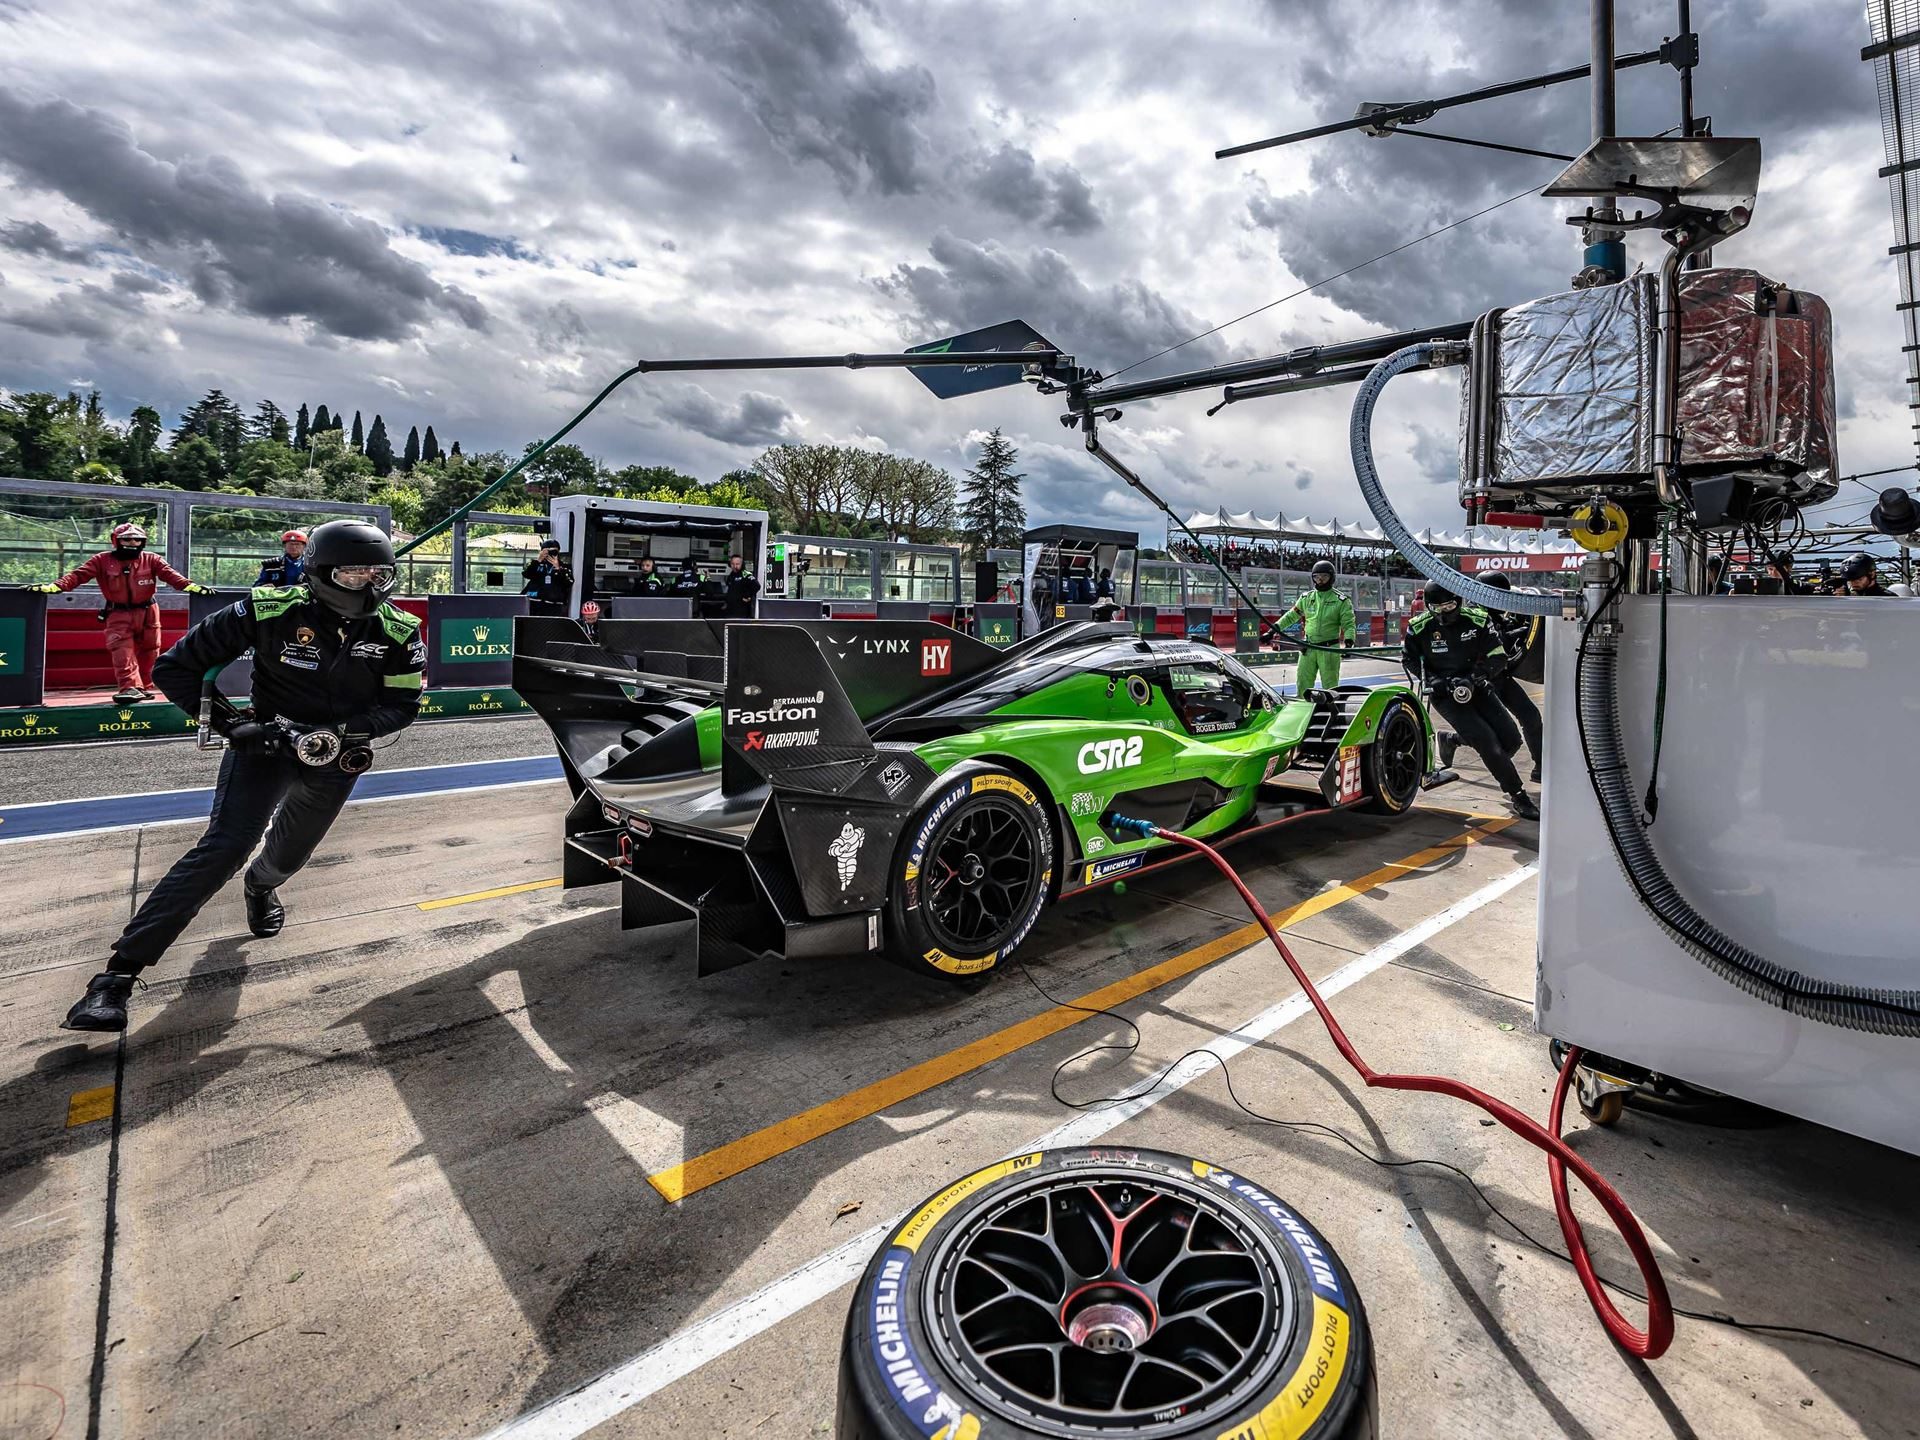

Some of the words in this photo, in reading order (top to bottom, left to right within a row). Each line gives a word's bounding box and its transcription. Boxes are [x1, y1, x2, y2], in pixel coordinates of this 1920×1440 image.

[1476, 556, 1529, 569] MOTUL
[258, 604, 279, 612] OMP
[1056, 607, 1064, 616] 83
[390, 624, 408, 635] OMP
[1188, 624, 1210, 634] WEC
[984, 635, 1011, 643] ROLEX
[352, 641, 389, 654] WEC
[450, 644, 511, 656] ROLEX
[864, 640, 910, 653] LYNX
[923, 645, 949, 670] HY
[469, 702, 503, 711] ROLEX
[773, 696, 816, 705] PERTAMINA
[727, 706, 816, 726] Fastron
[1, 726, 59, 738] ROLEX
[98, 721, 151, 732] ROLEX
[1196, 724, 1216, 733] ROGER
[1217, 721, 1237, 731] DUBUIS
[1077, 735, 1144, 774] CSR2
[976, 779, 994, 787] PILOT
[994, 778, 1012, 787] SPORT
[1023, 790, 1032, 800] M
[916, 786, 966, 850] MICHELIN
[1087, 840, 1104, 850] BMC
[1102, 857, 1137, 874] MICHELIN
[1013, 1155, 1032, 1169] M
[907, 1208, 936, 1238] PILOT
[936, 1180, 974, 1208] SPORT
[1236, 1185, 1338, 1293] MICHELIN
[876, 1260, 931, 1402] MICHELIN
[1325, 1313, 1338, 1359] PILOT
[1300, 1358, 1330, 1409] SPORT
